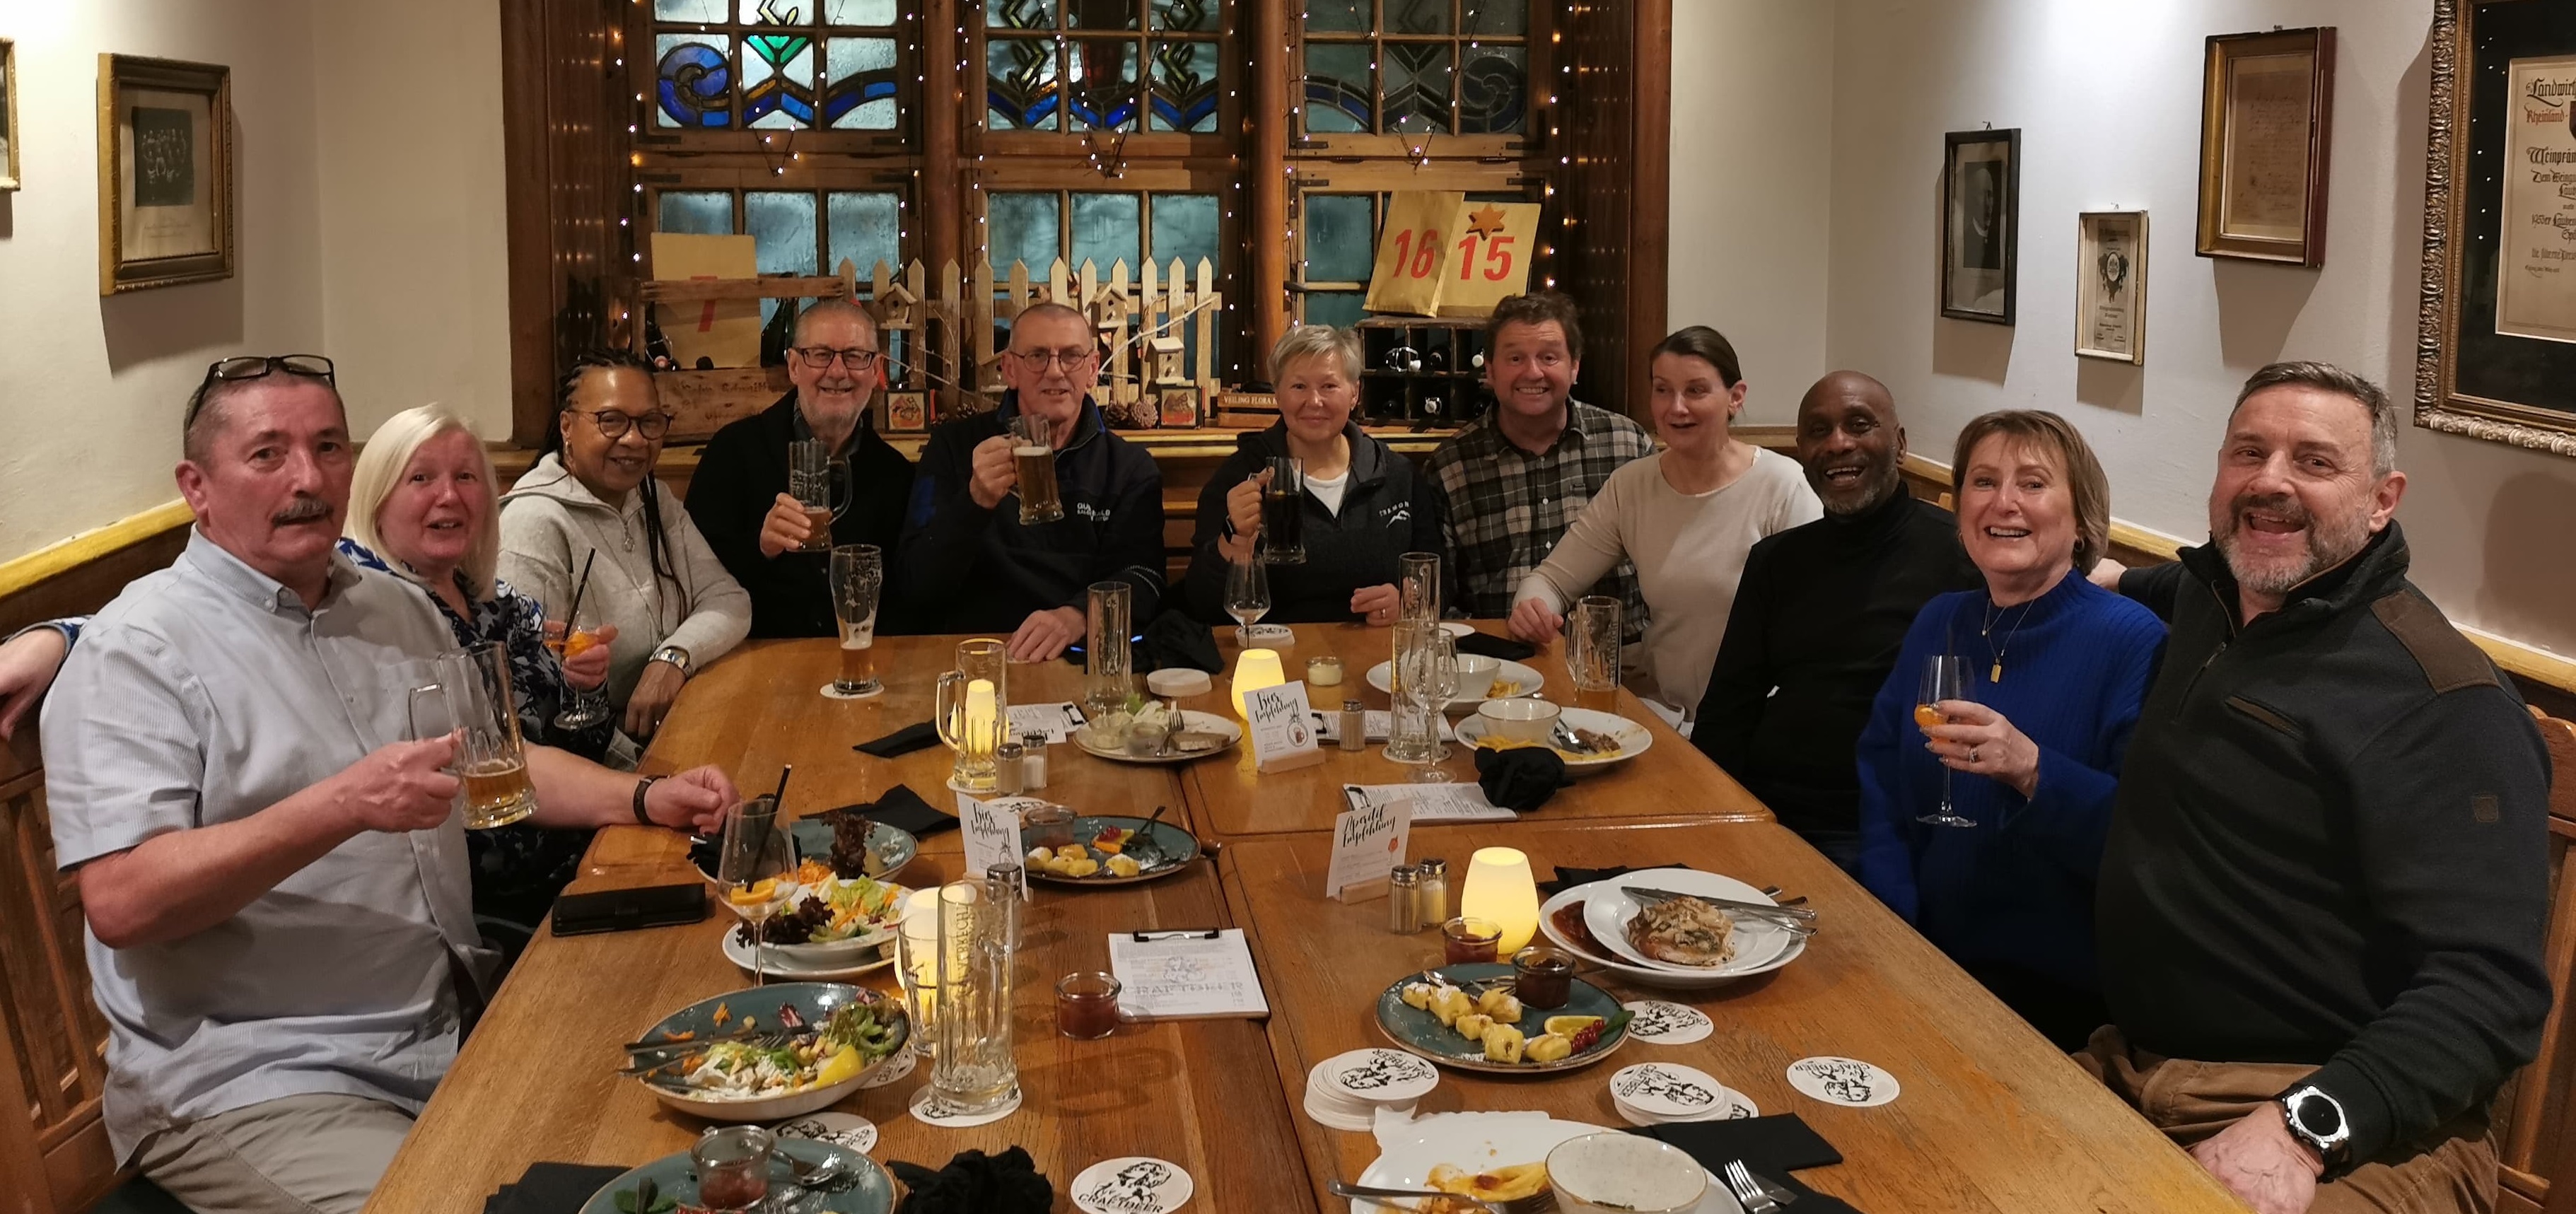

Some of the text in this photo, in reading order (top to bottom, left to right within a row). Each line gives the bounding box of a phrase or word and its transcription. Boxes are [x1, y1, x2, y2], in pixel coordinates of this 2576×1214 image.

[1392, 228, 1438, 279] 16
[1457, 235, 1515, 281] 15
[1223, 395, 1249, 404] VEILING
[1251, 396, 1271, 405] FLORA
[1255, 698, 1298, 723] Empfehlung
[971, 820, 1010, 844] Empfehlung
[1343, 816, 1395, 848] Empfehlung
